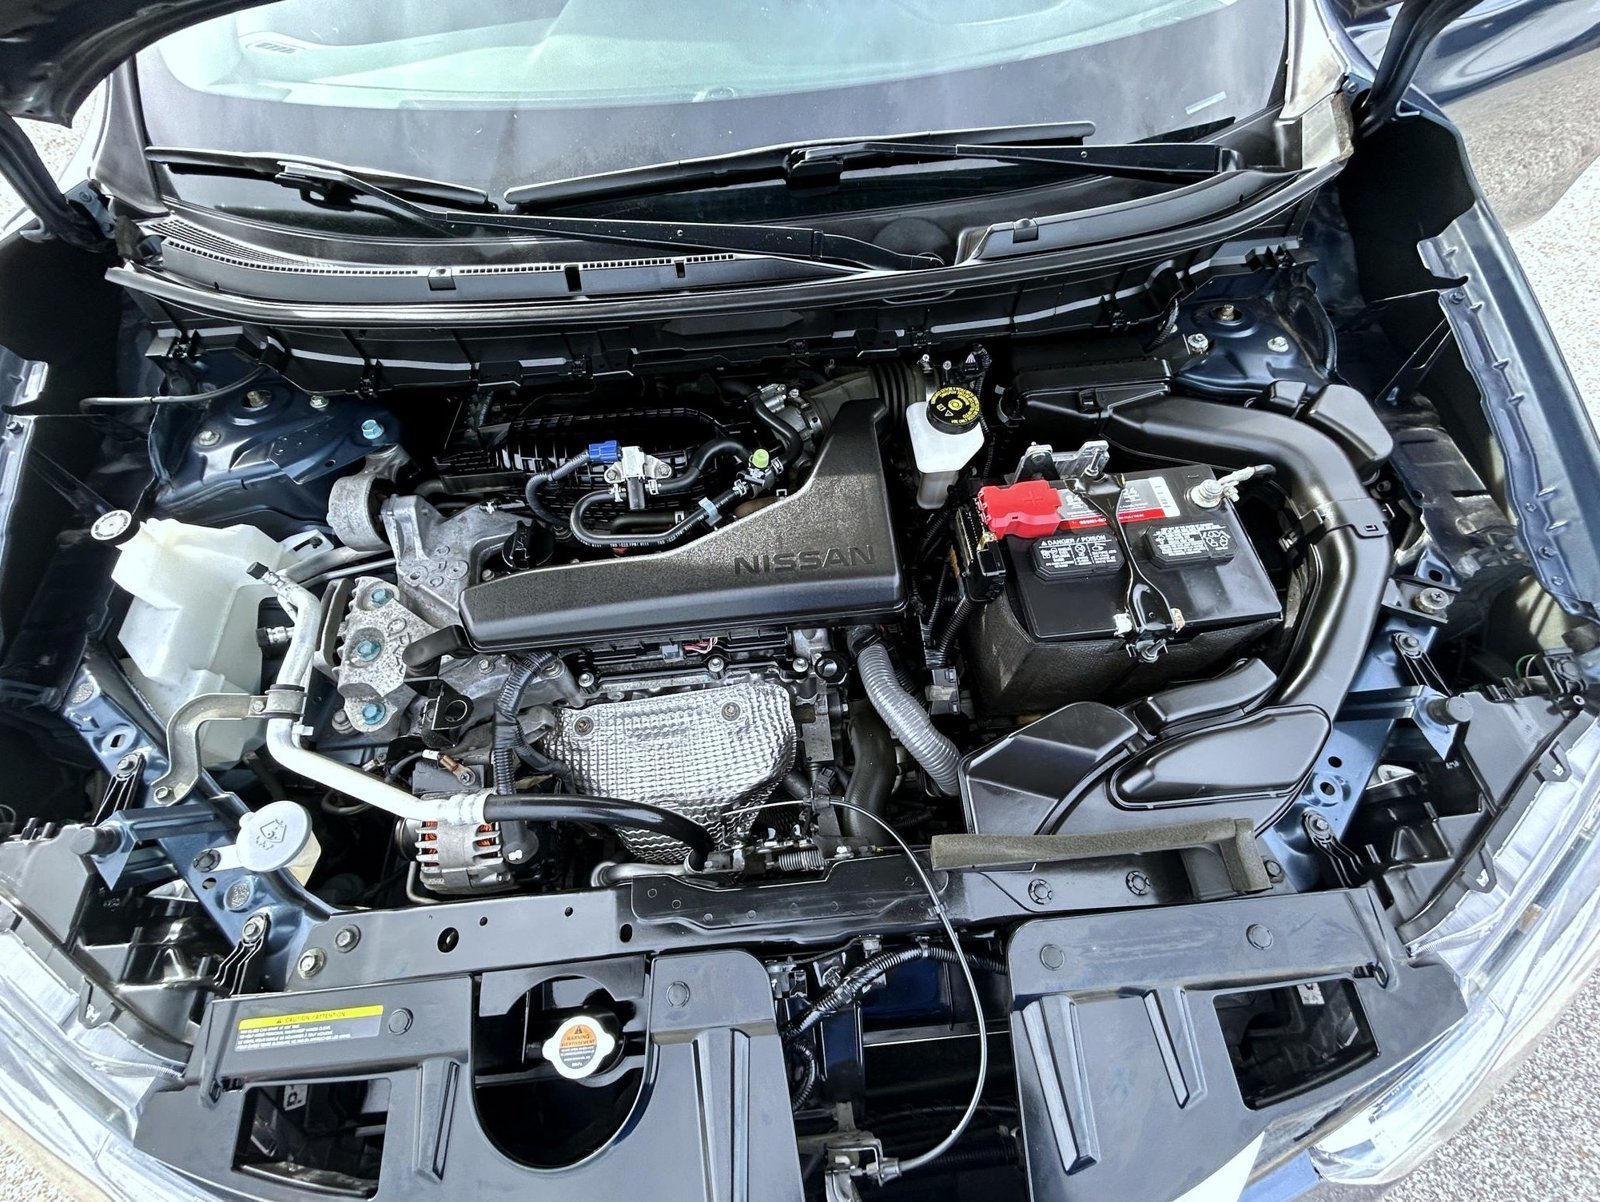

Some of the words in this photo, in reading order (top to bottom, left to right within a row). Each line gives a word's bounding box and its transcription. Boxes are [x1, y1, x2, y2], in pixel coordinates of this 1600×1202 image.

[1047, 538, 1075, 546] DANGER
[1080, 534, 1107, 543] POISON
[734, 545, 875, 575] NISSAN
[285, 1015, 310, 1023] CAUTION
[315, 1012, 346, 1020] ATTENTION
